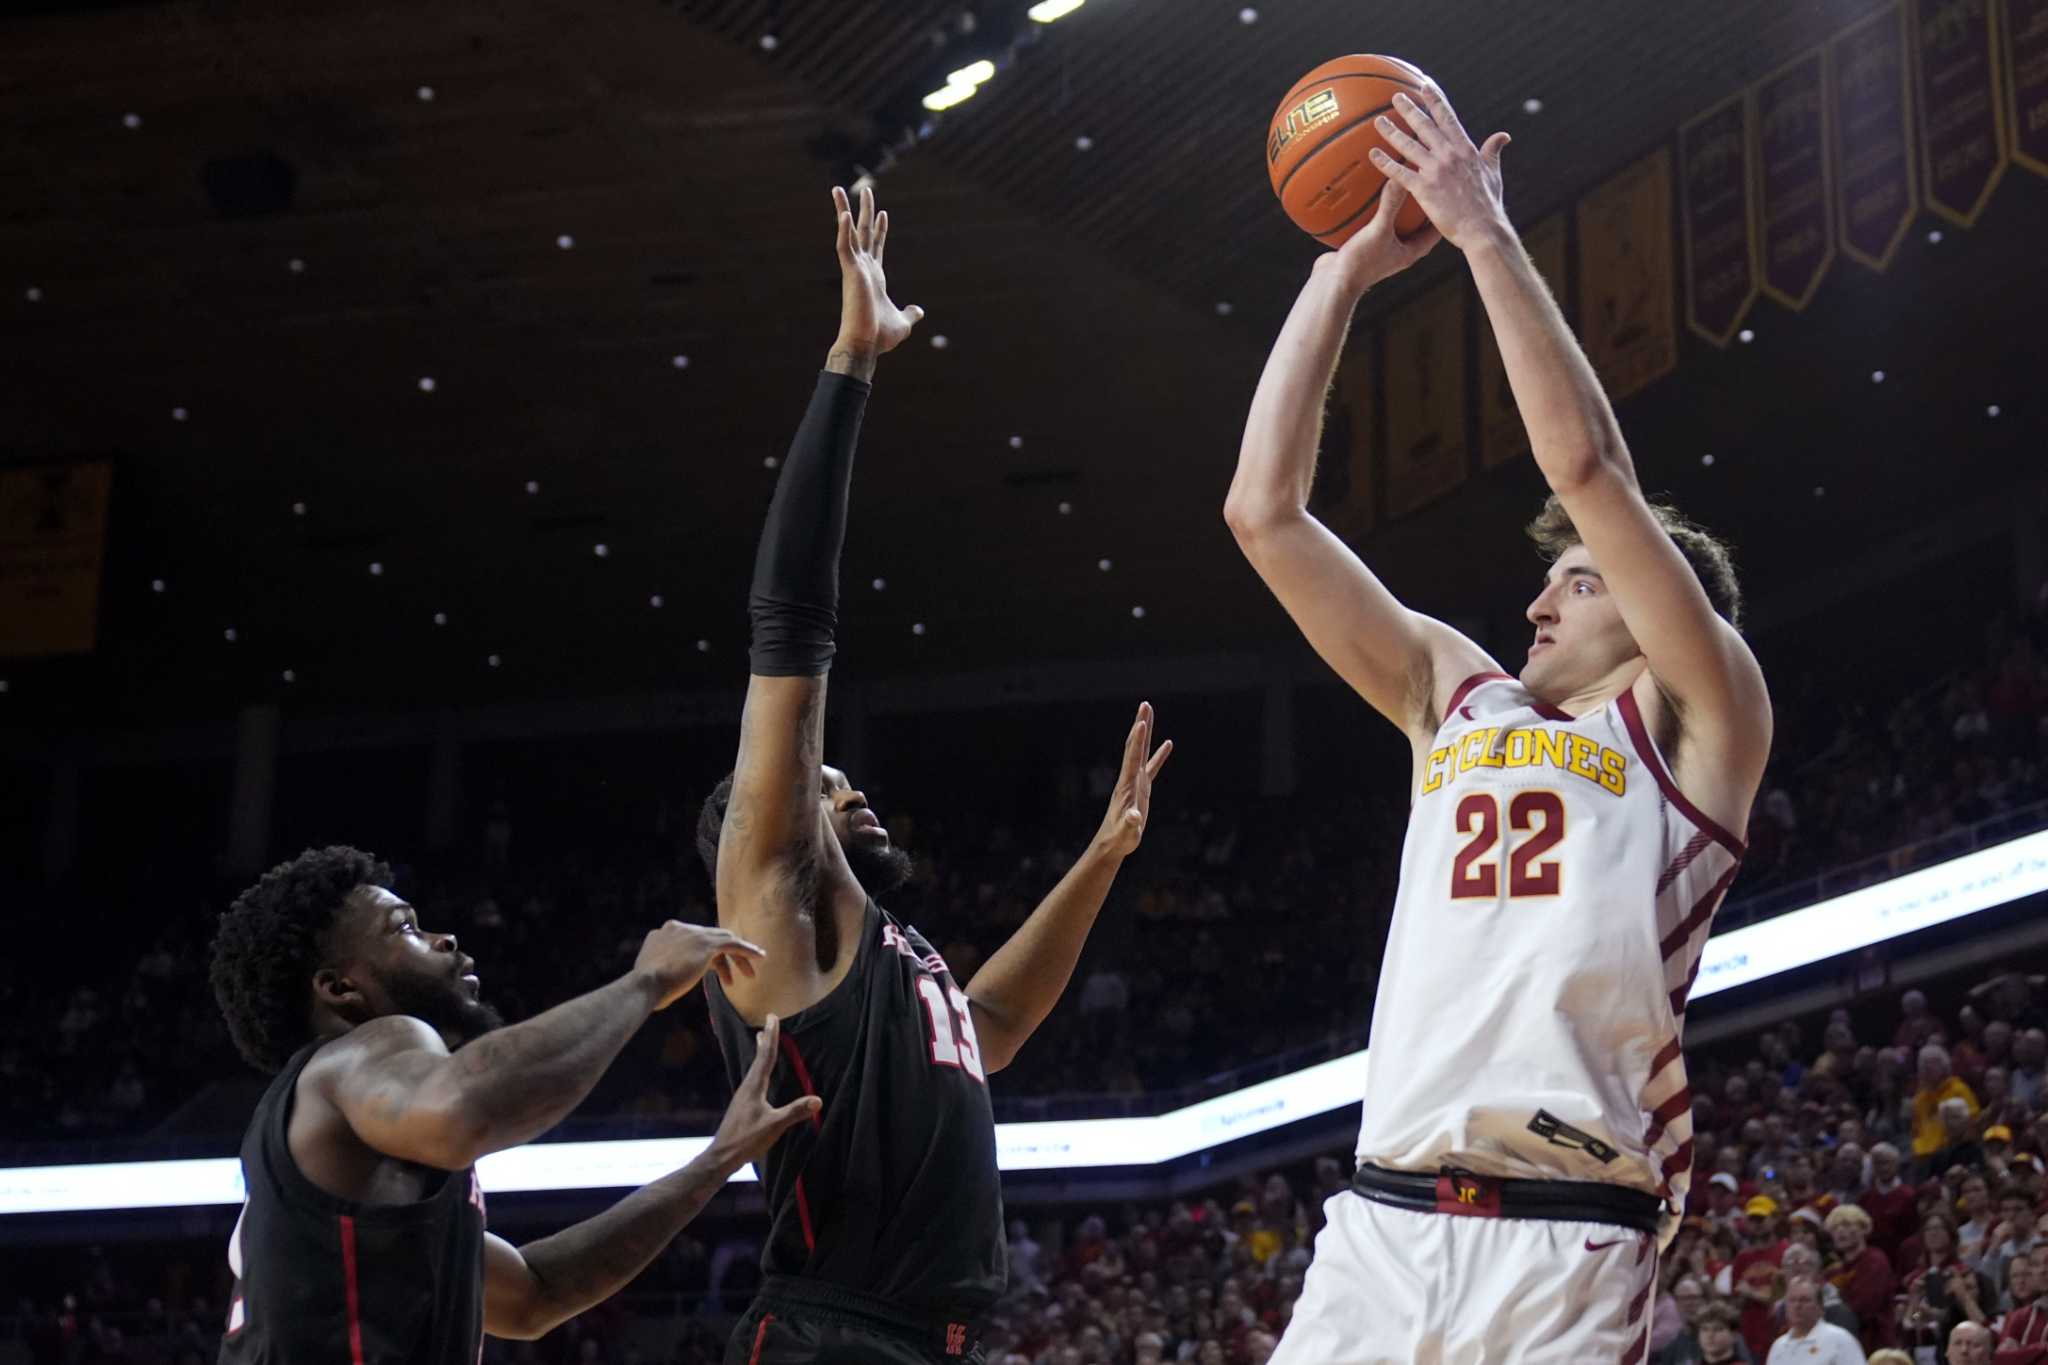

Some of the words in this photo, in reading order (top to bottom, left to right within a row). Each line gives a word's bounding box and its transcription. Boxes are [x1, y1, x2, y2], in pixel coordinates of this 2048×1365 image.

[1423, 727, 1626, 796] CYCLONES
[1451, 789, 1565, 898] 22
[915, 976, 985, 1083] 13
